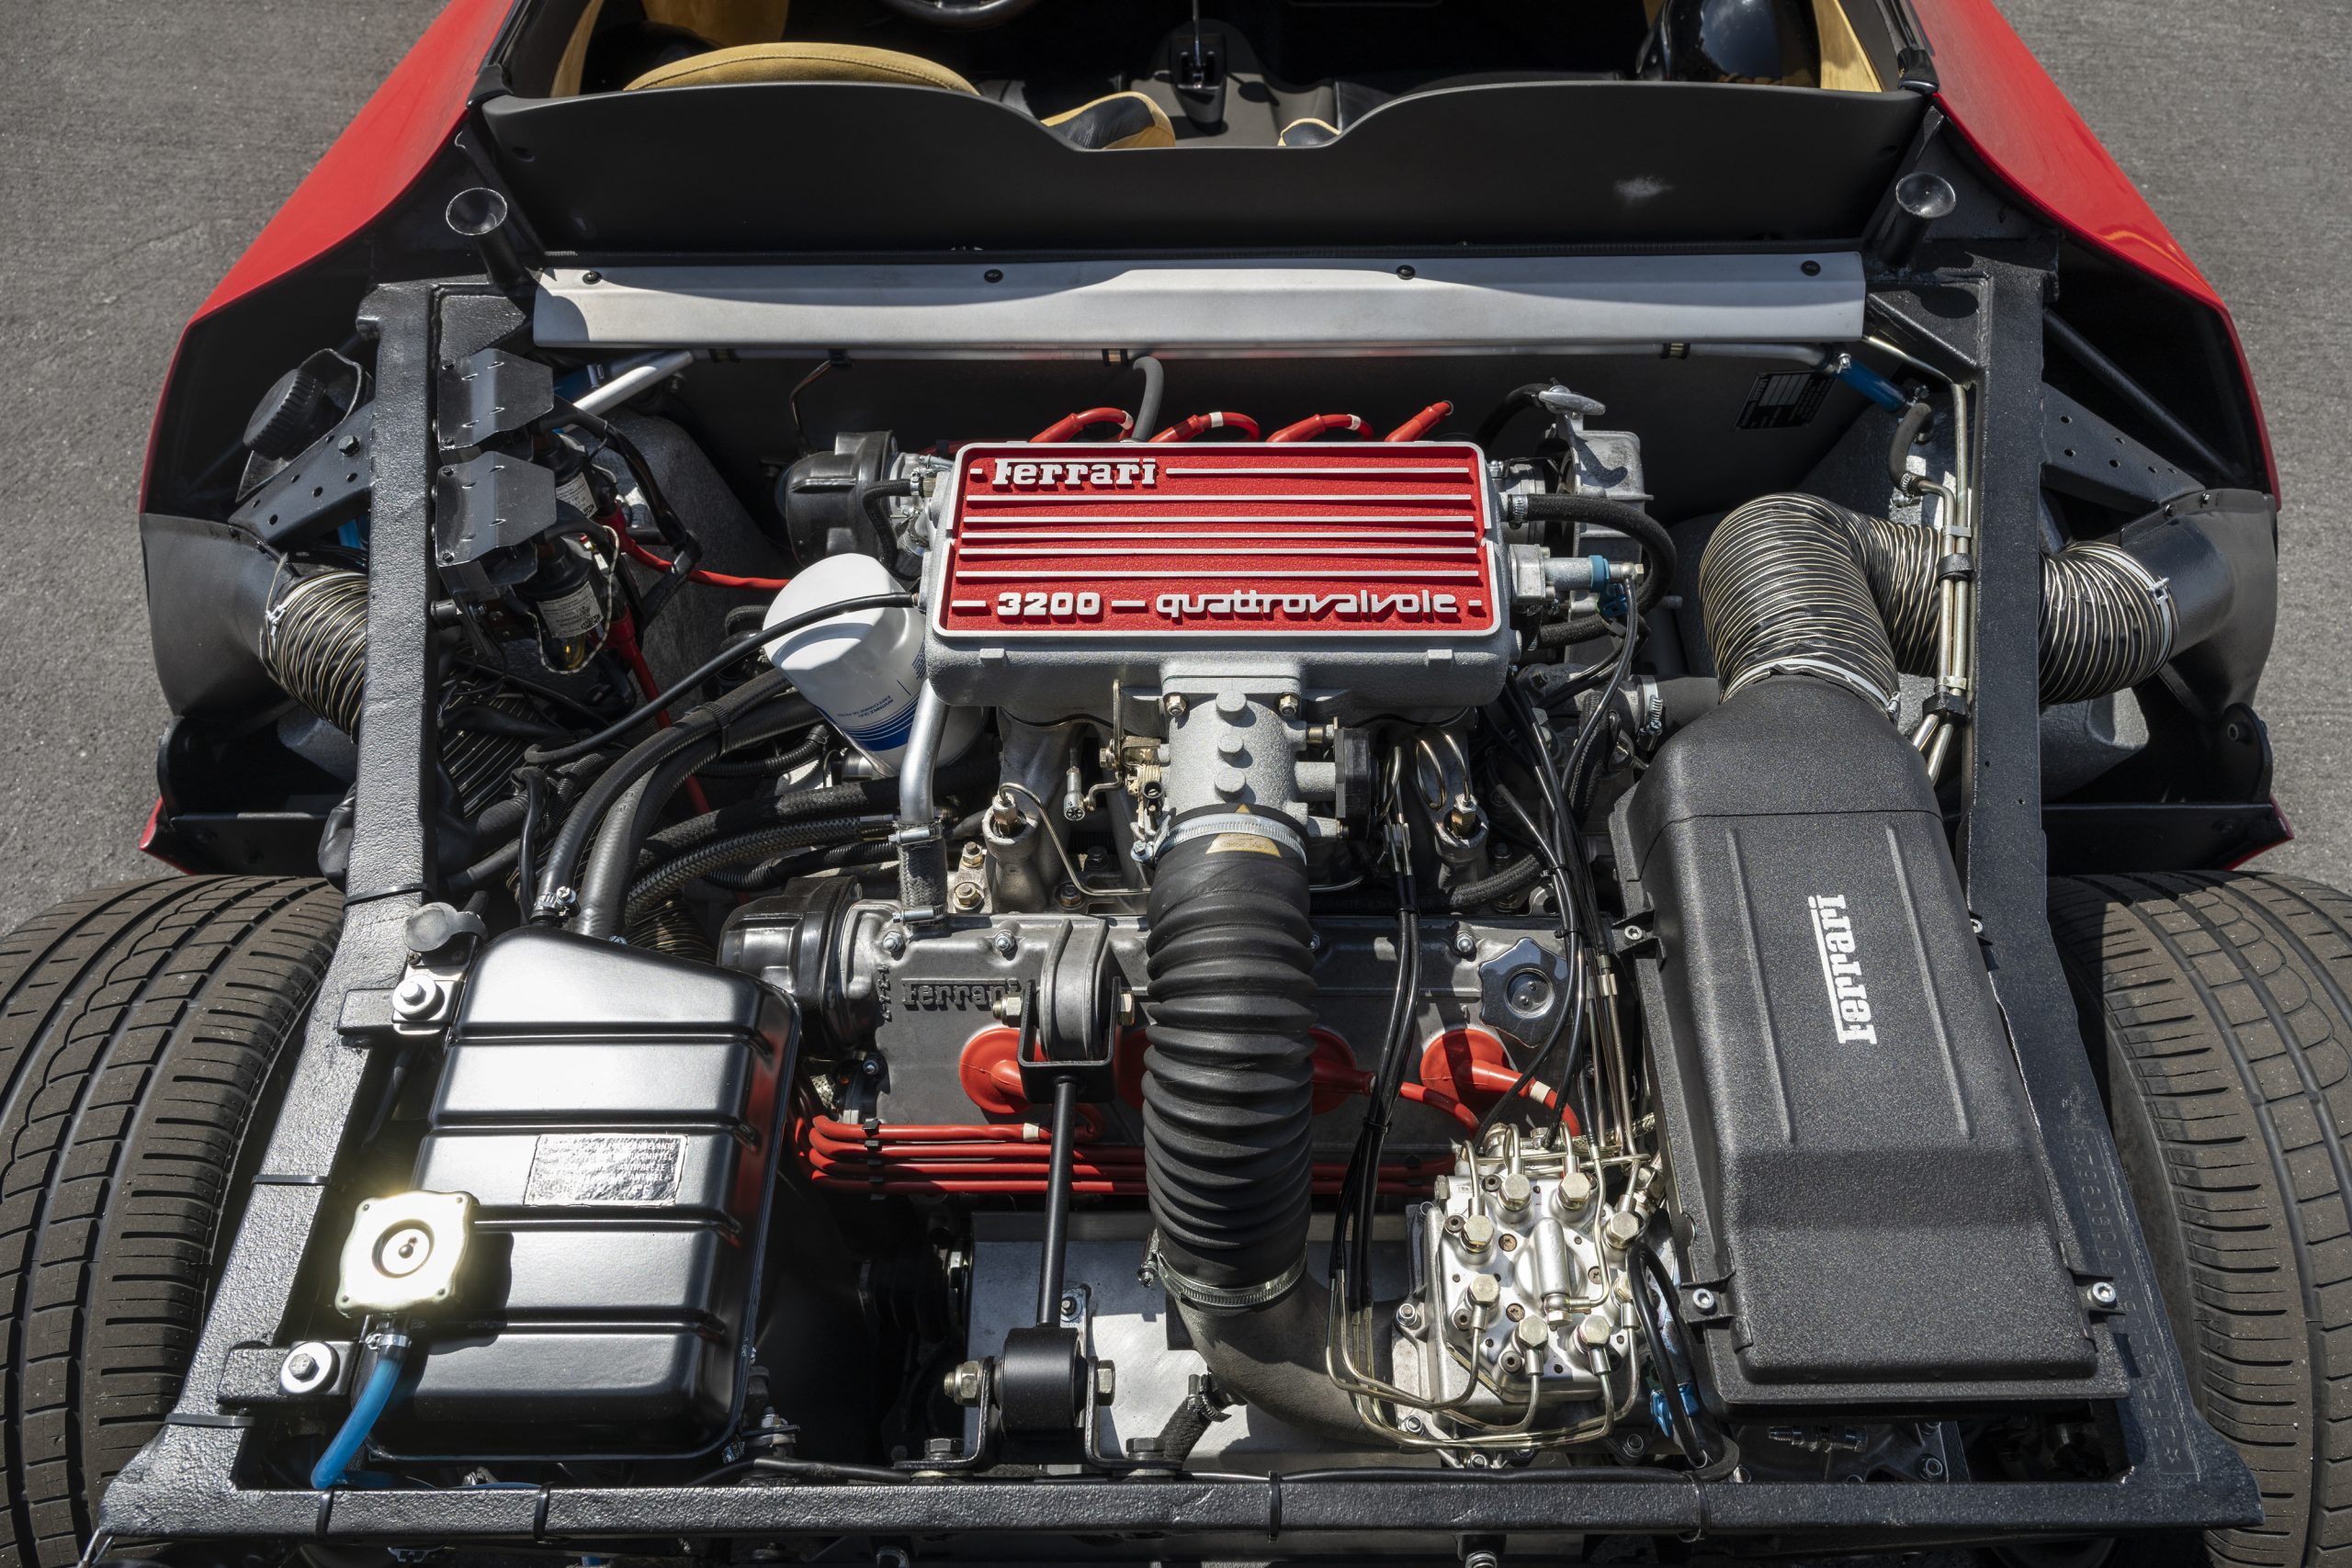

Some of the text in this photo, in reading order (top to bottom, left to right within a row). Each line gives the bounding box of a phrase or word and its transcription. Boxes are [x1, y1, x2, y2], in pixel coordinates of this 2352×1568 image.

[992, 457, 1156, 485] Ferrari
[997, 589, 1457, 618] 3200 quattrovalvole
[1807, 894, 1878, 1045] Ferrari
